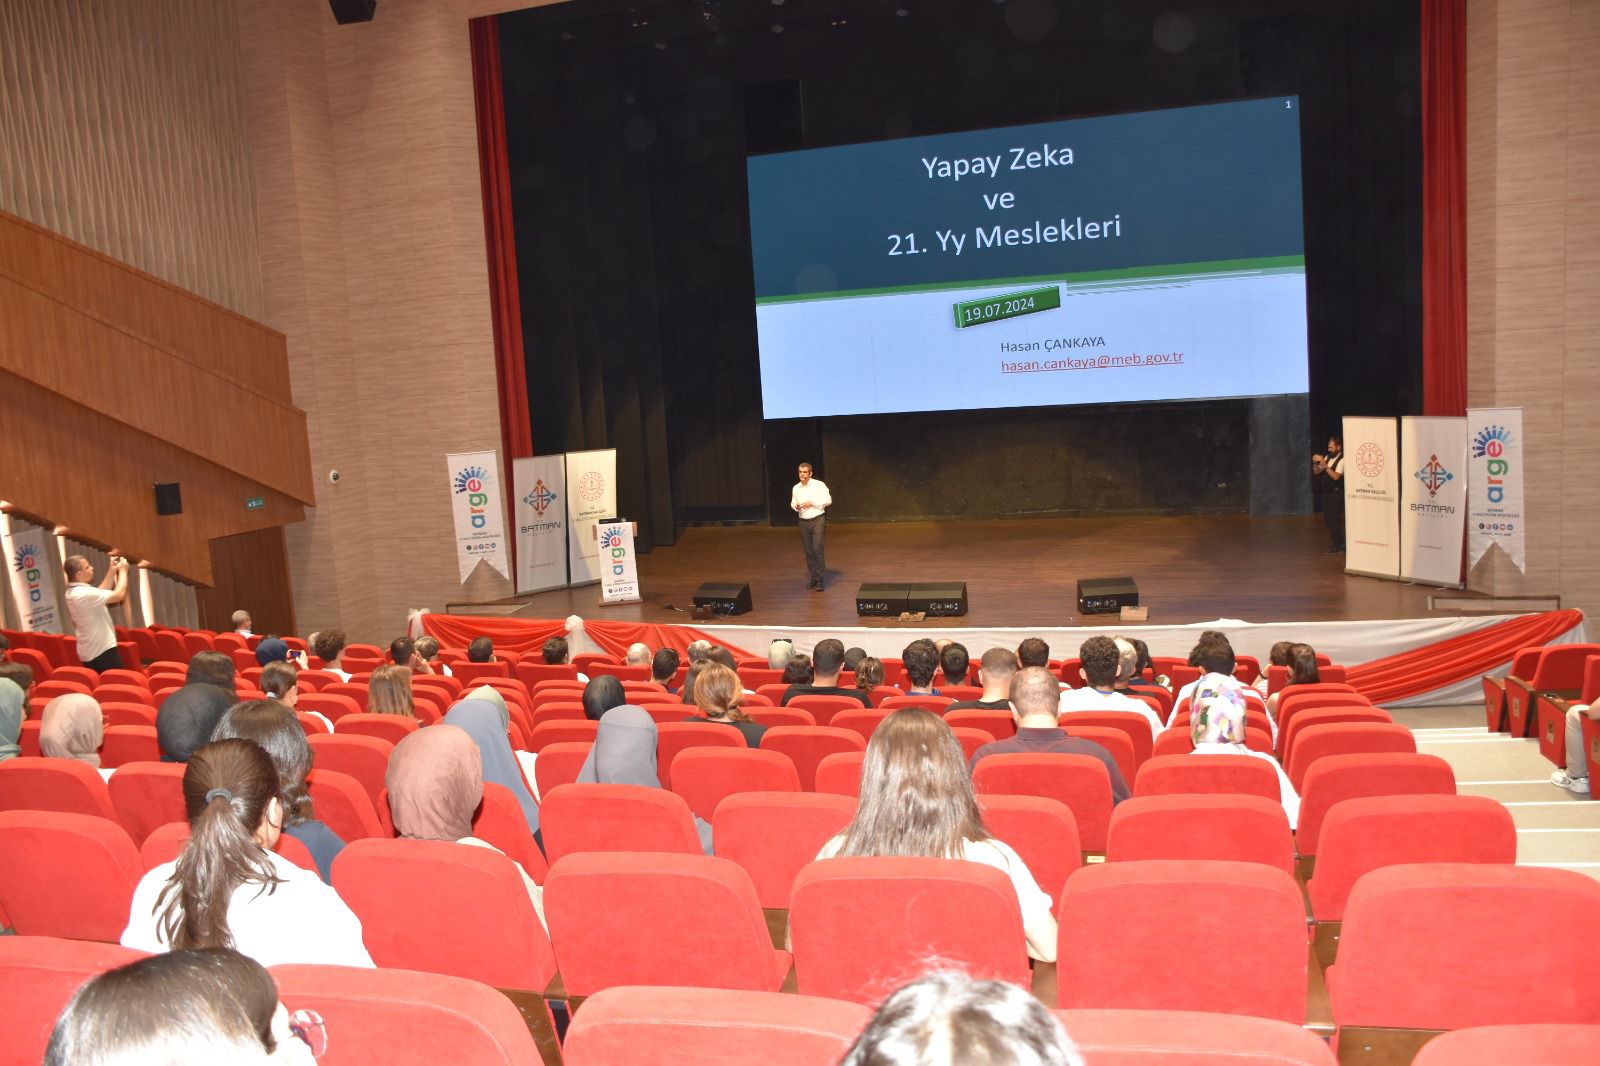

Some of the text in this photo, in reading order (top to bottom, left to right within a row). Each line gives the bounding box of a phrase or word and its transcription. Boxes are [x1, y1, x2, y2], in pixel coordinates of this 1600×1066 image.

[1284, 100, 1292, 110] 1
[921, 144, 1075, 182] Yapay Zeka
[983, 193, 1015, 210] ve
[887, 214, 1122, 257] 21. Yy Meslekleri
[964, 296, 1036, 323] 19.07.2024
[1000, 337, 1106, 353] Hasan ÇANKAYA
[1000, 351, 1185, 374] hasan.cankaya@meb.gov.tr
[1487, 441, 1508, 503] arge
[467, 479, 488, 528] arge
[1410, 503, 1455, 514] BATMAN
[521, 521, 561, 534] BATMAN
[610, 536, 626, 576] arge
[23, 556, 41, 602] arge
